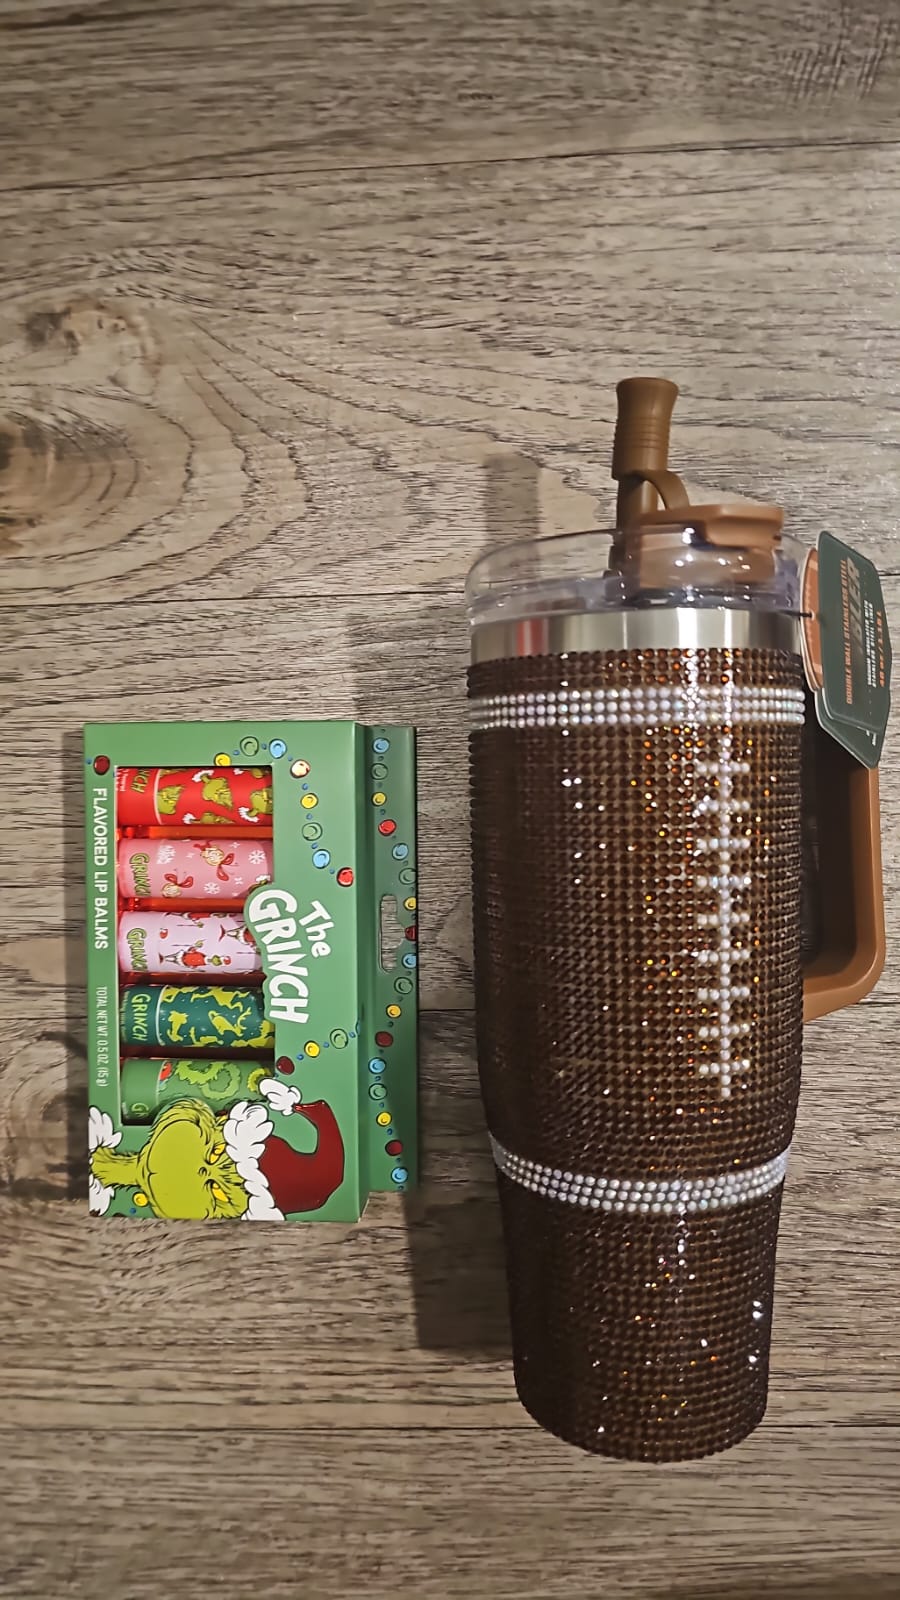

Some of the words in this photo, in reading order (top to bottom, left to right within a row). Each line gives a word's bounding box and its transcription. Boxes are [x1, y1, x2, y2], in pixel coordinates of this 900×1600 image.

[840, 559, 848, 587] STEEL
[842, 588, 850, 640] STAINLESS
[847, 557, 863, 656] BLER
[844, 667, 852, 705] DOUBLE
[93, 788, 108, 866] FLAVORED
[94, 871, 109, 893] LIP
[94, 897, 109, 949] BALMS
[298, 900, 335, 958] The
[248, 889, 310, 1024] GRINCH
[96, 986, 108, 1008] TOTAL
[96, 1009, 108, 1024] NET
[131, 993, 152, 1041] GRINCH
